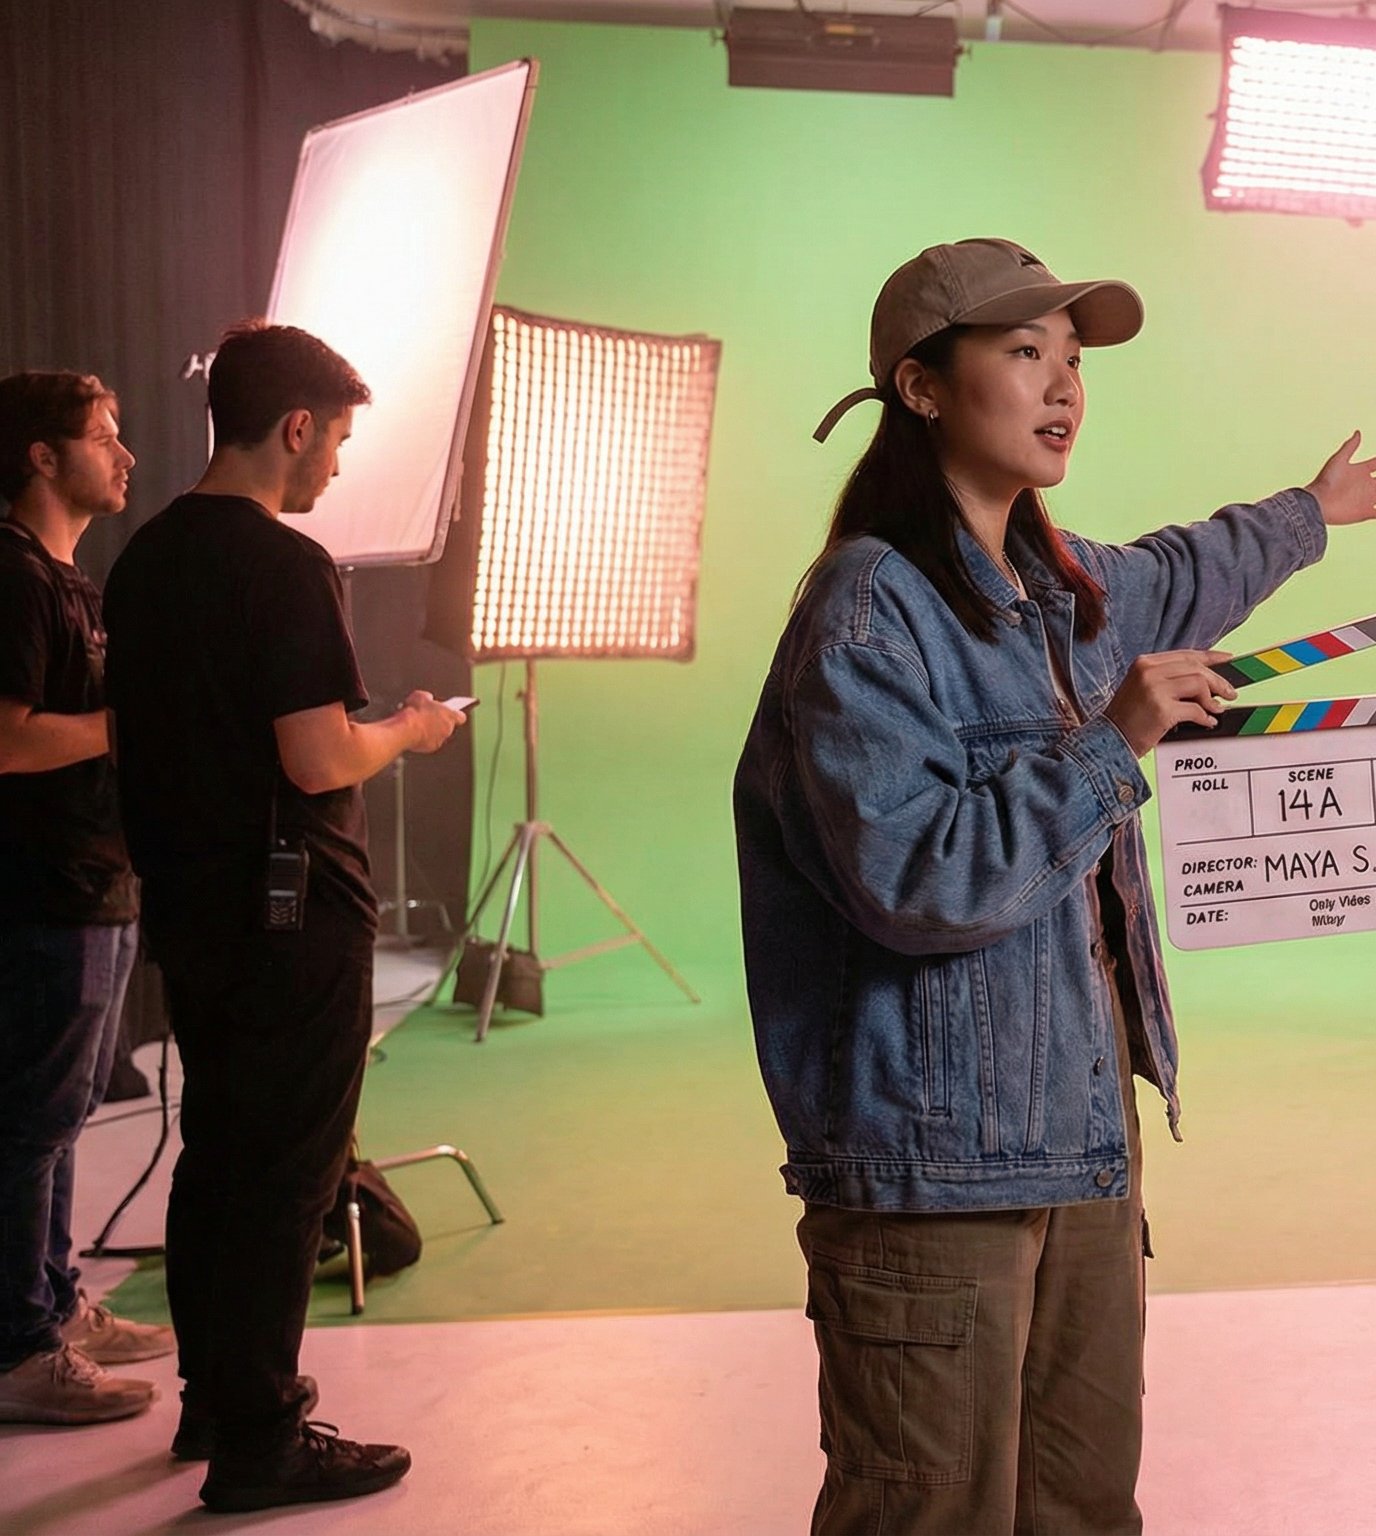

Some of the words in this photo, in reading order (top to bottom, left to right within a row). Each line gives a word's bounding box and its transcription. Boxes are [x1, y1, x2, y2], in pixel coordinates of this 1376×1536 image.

[1191, 777, 1229, 793] ROLL
[1287, 767, 1335, 784] SCENE
[1277, 786, 1343, 822] 14A
[1181, 856, 1259, 876] DIRECTOR:
[1264, 849, 1340, 883] MAYA
[1183, 879, 1245, 898] CAMERA
[1186, 910, 1230, 927] DATE:
